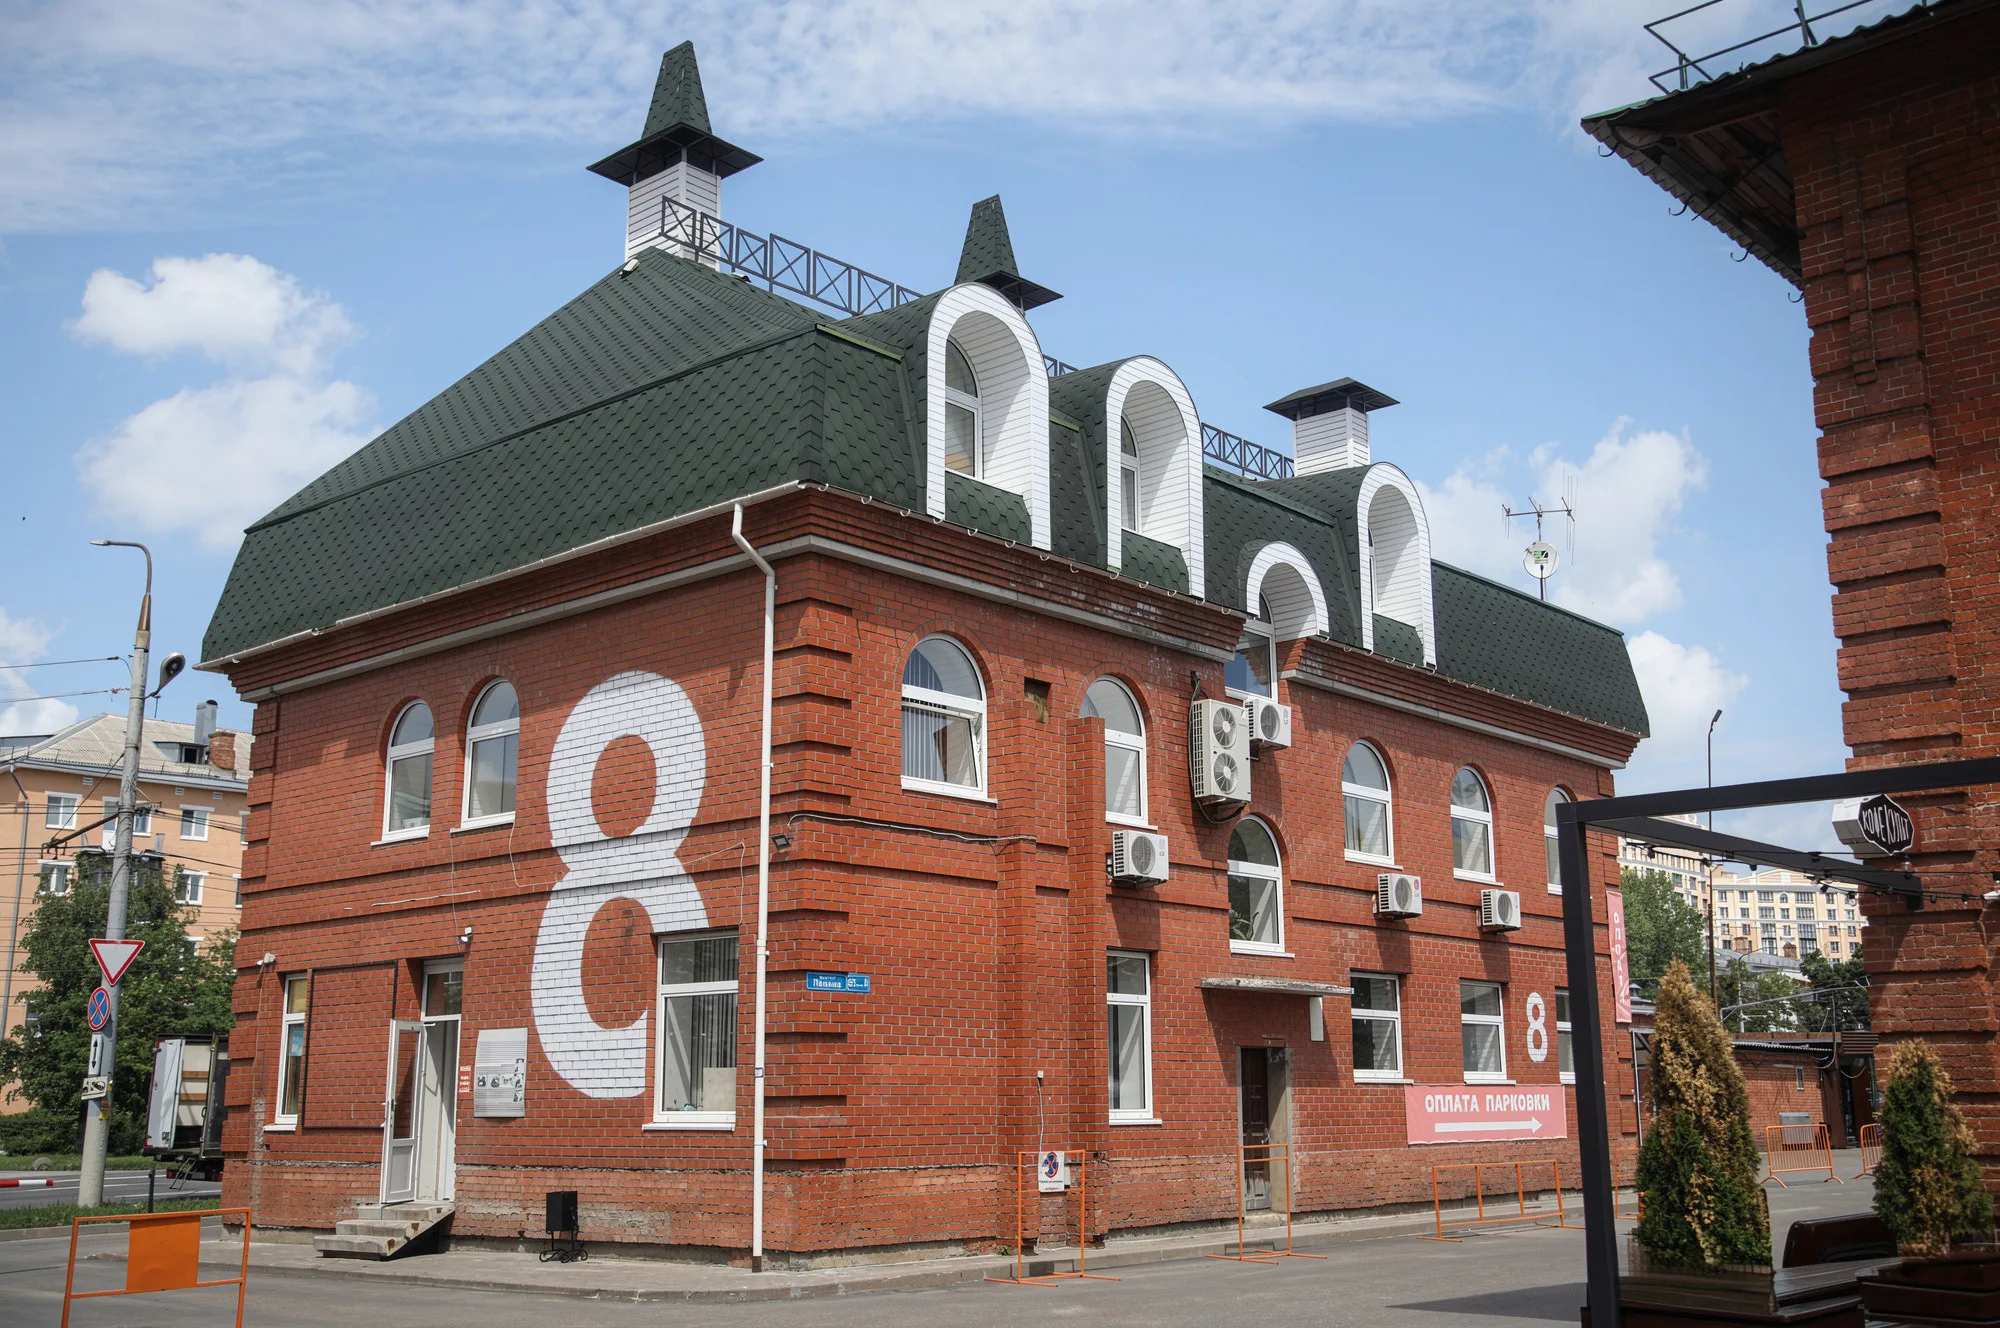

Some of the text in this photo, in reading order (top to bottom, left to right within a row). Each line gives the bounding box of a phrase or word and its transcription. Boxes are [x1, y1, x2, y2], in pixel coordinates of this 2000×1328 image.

[531, 670, 710, 1099] 8
[1526, 992, 1548, 1062] 8
[1425, 1094, 1550, 1113] ОПЛАТА ПАРКОВКИ
